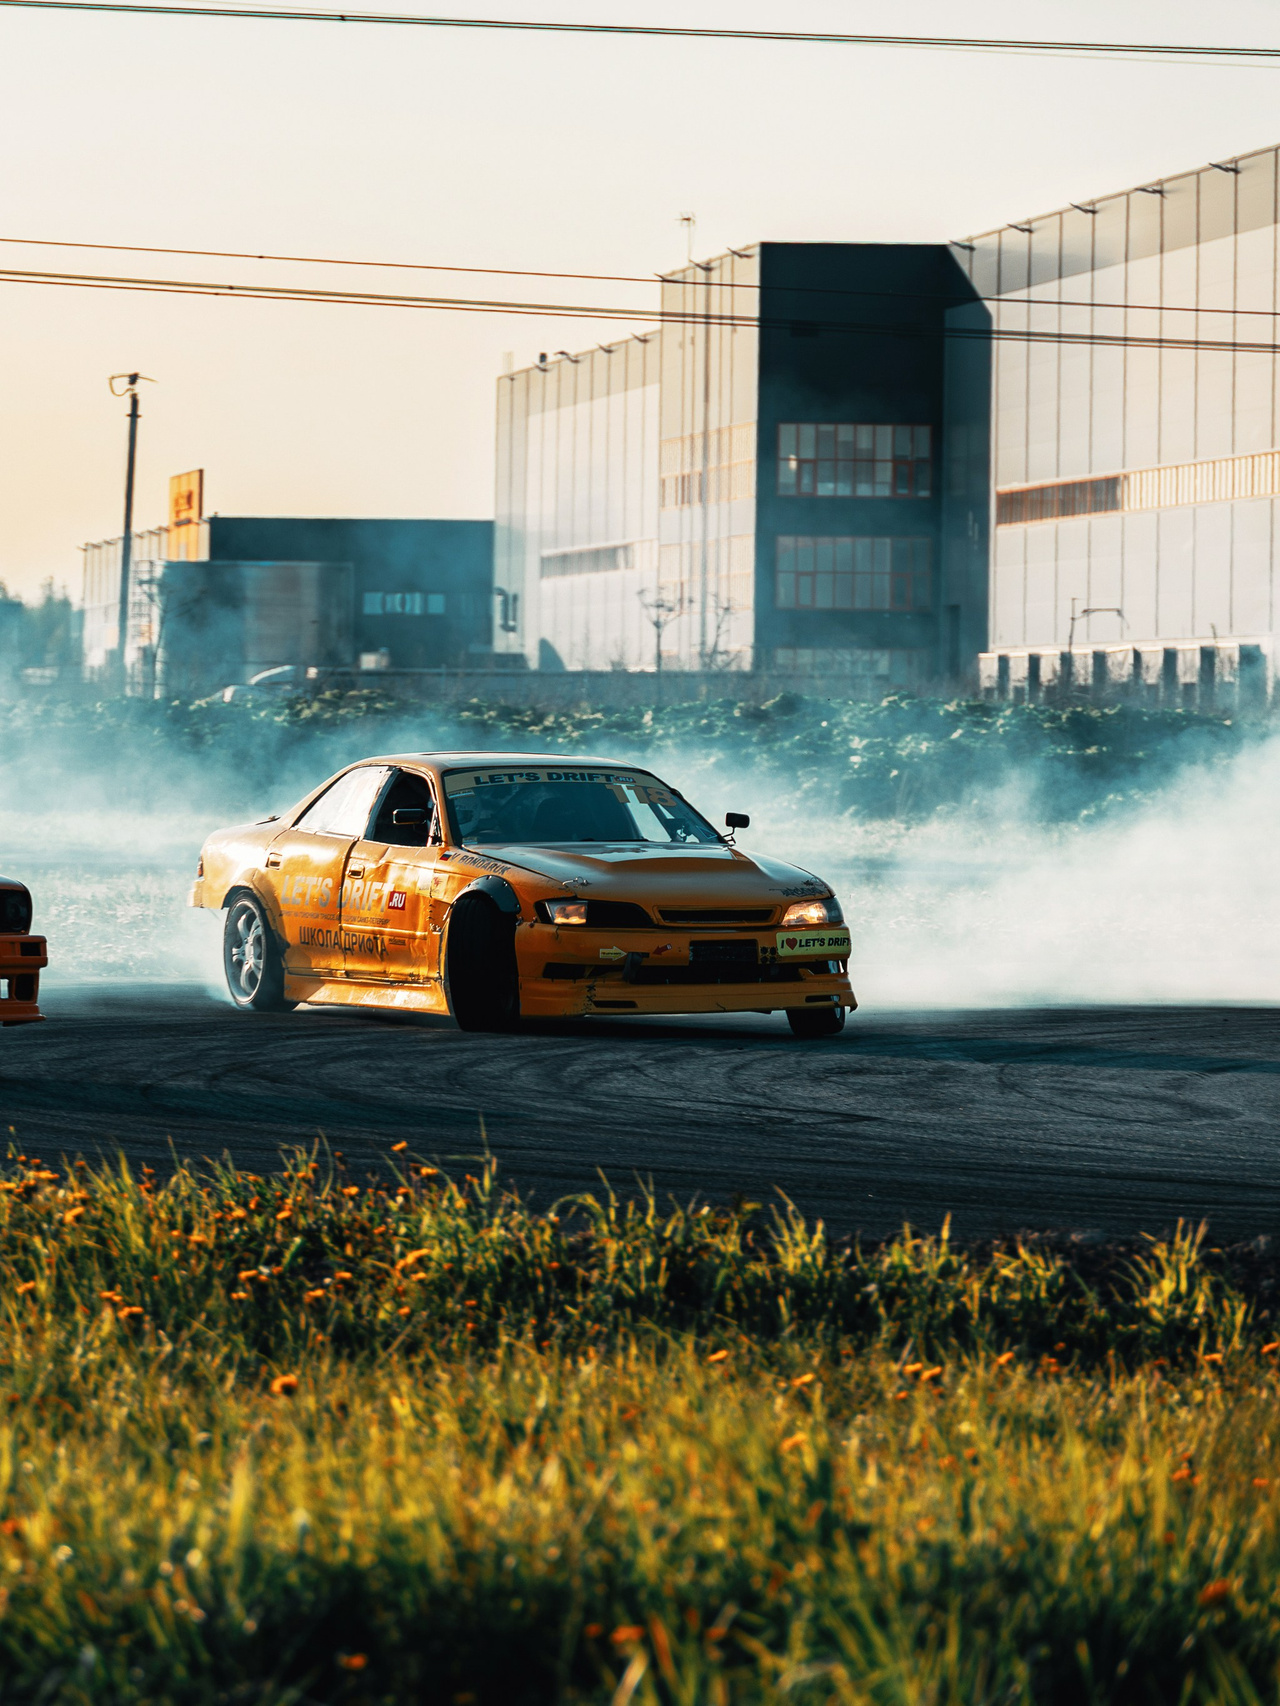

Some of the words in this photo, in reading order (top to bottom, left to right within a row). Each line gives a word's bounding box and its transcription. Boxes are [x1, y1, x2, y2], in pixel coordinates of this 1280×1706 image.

[473, 772, 541, 785] LET'S
[605, 784, 677, 807] 118
[280, 875, 333, 908] LET'S
[299, 926, 341, 949] ШКОЛА
[342, 932, 389, 957] ДРИФТА
[798, 938, 825, 948] LET'S
